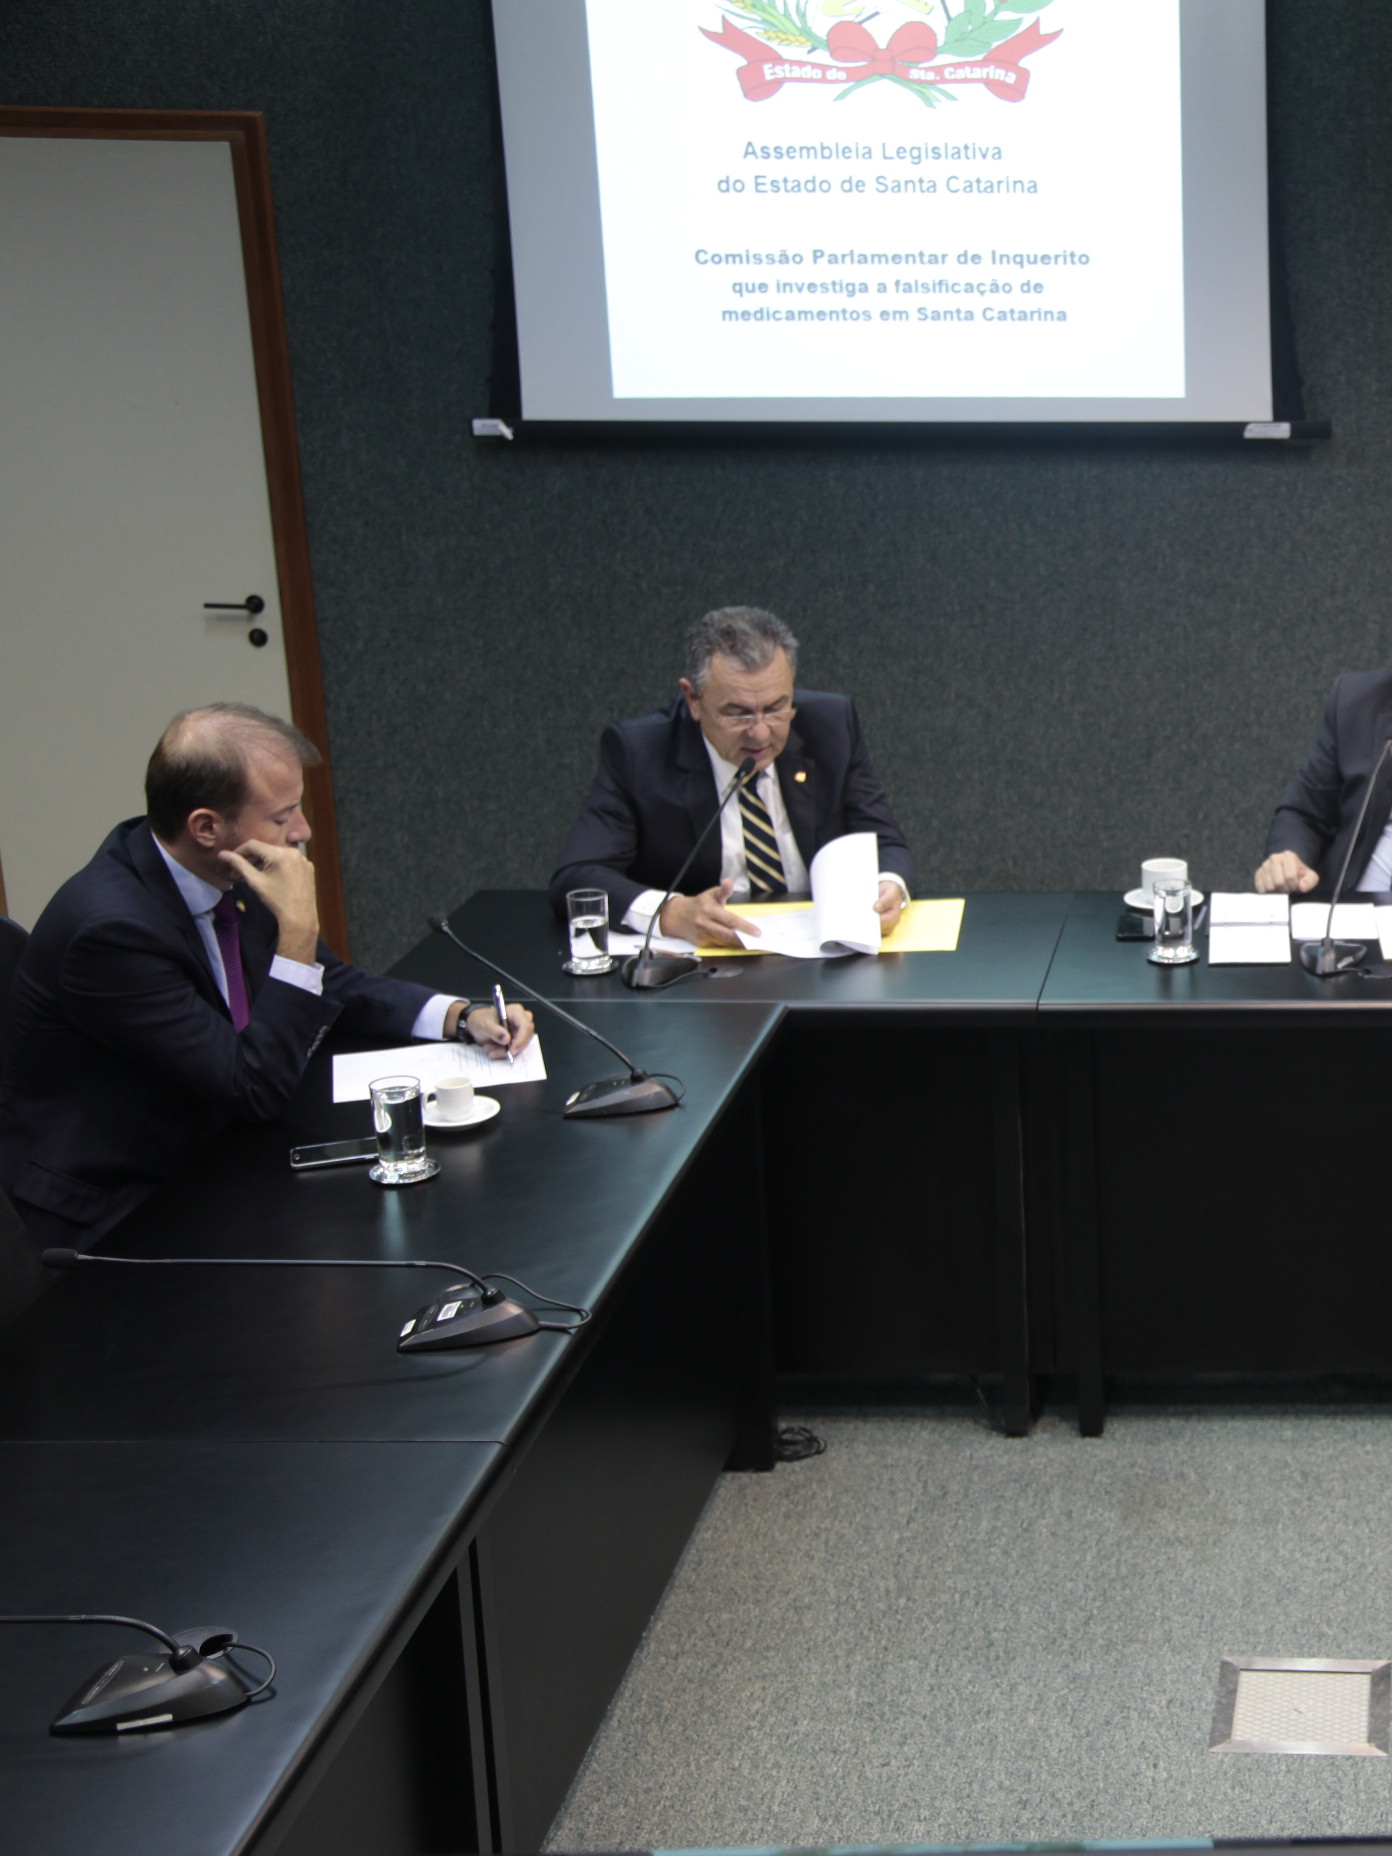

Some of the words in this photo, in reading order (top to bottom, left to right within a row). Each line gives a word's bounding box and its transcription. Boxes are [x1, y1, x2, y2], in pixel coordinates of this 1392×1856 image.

[762, 63, 822, 82] Estado
[826, 64, 847, 81] de
[908, 67, 940, 81] Sta.
[943, 67, 1017, 84] Catarina
[743, 141, 872, 160] Assembleia
[882, 141, 1002, 165] Legislativa
[718, 175, 746, 194] do
[754, 175, 831, 194] Estado
[840, 175, 865, 194] de
[876, 175, 937, 194] Santa
[946, 175, 1037, 194] Catarina
[695, 248, 803, 266] Comissão
[812, 248, 948, 266] Parlamentar
[957, 249, 982, 266] de
[991, 249, 1091, 269] Inquerito
[732, 281, 768, 299] que
[776, 279, 868, 298] investiga
[877, 281, 887, 294] a
[894, 278, 1012, 298] falsificação
[1020, 279, 1043, 295] de
[722, 306, 872, 322] medicamentos
[880, 309, 909, 322] em
[916, 306, 974, 322] Santa
[982, 306, 1068, 322] Catarina
